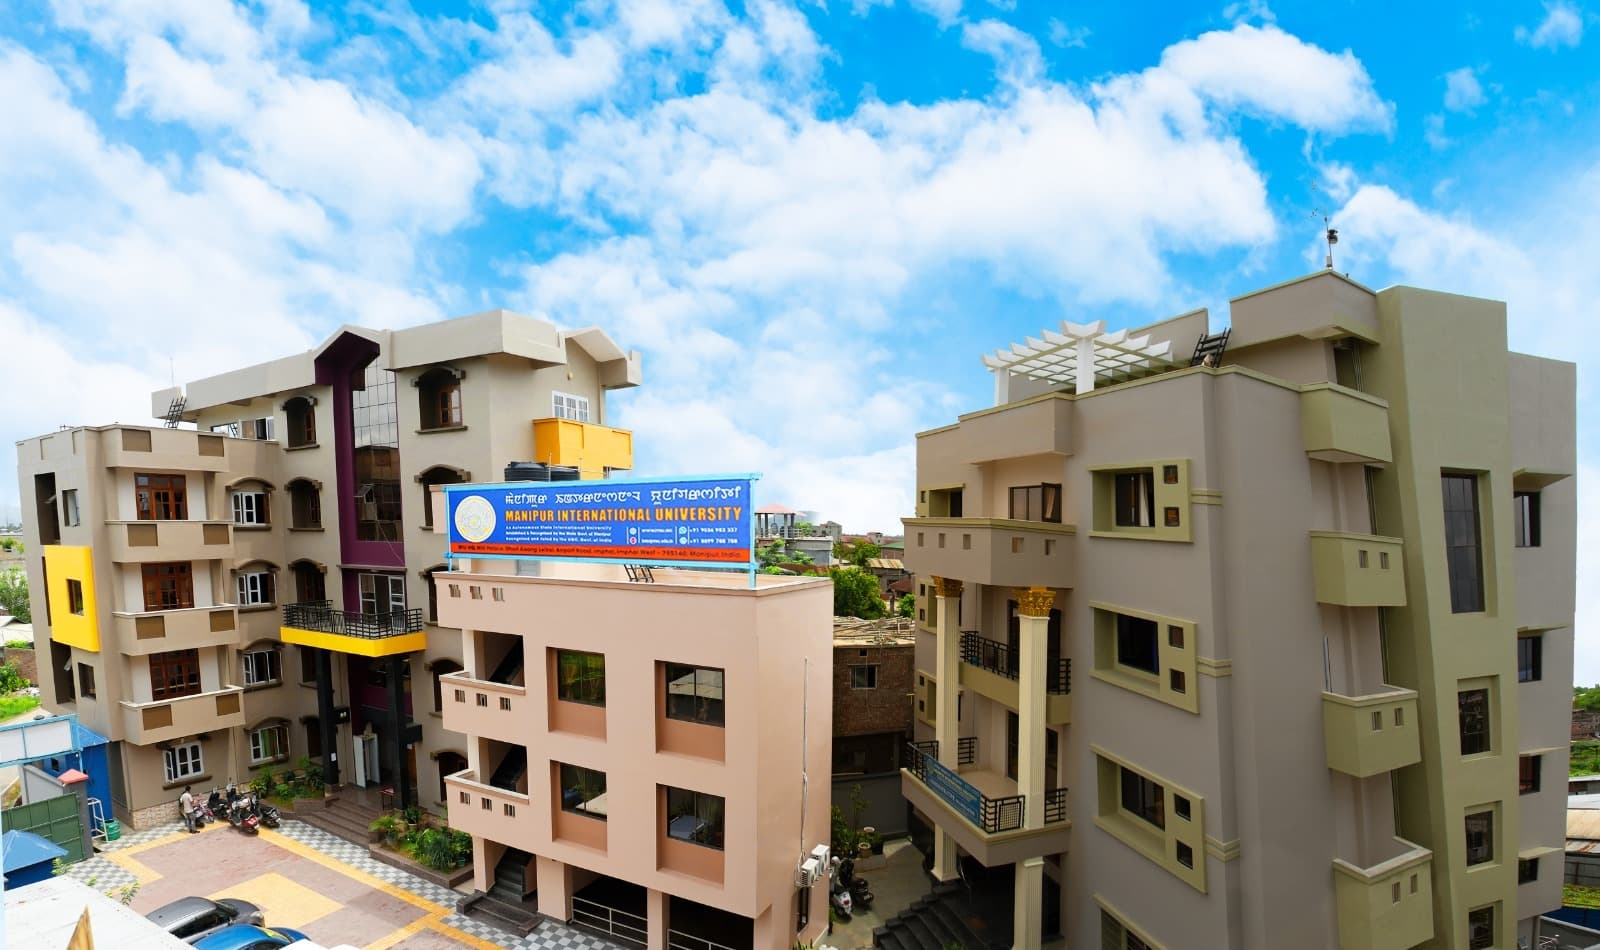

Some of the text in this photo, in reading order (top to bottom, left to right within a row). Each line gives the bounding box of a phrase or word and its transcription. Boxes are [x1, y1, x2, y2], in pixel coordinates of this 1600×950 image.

[505, 506, 742, 522] MANIPUR INTERNATIONAL UNIVERSITY
